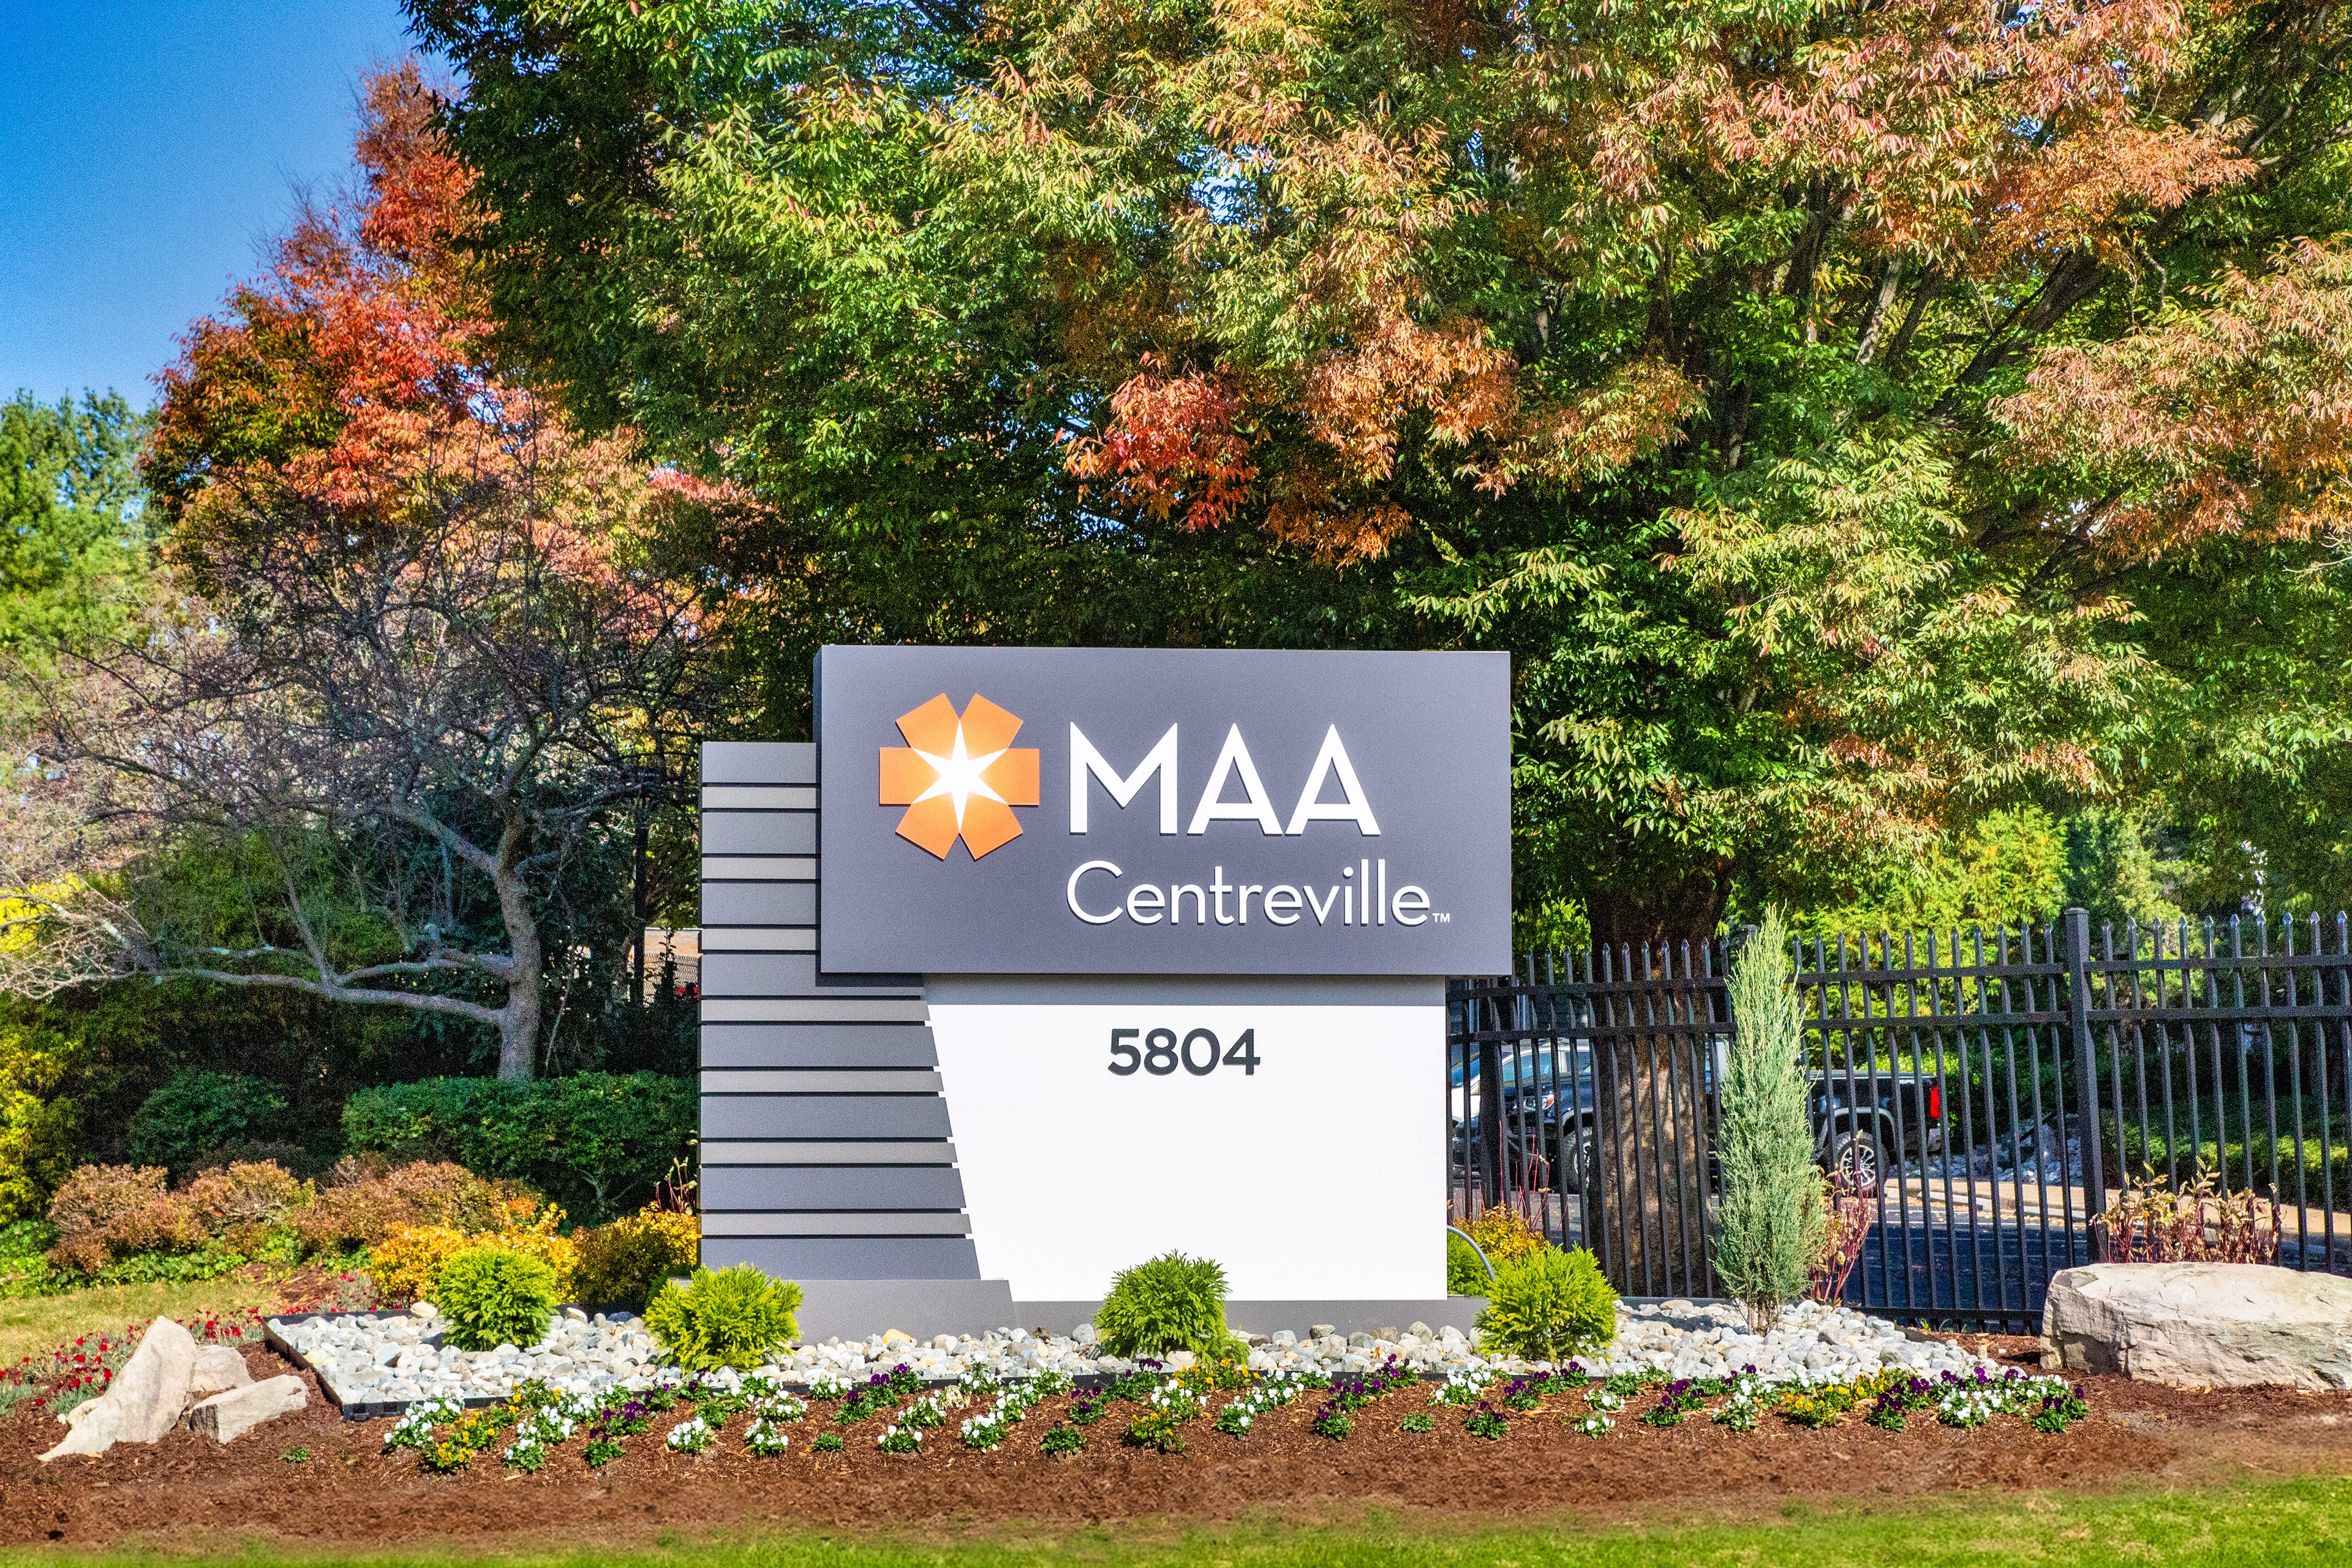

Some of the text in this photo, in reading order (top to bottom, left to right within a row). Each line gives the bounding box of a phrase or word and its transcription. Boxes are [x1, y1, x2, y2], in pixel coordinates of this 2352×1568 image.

[1069, 722, 1381, 835] MAA
[1067, 859, 1431, 925] Centreville
[1107, 1028, 1261, 1076] 5804
